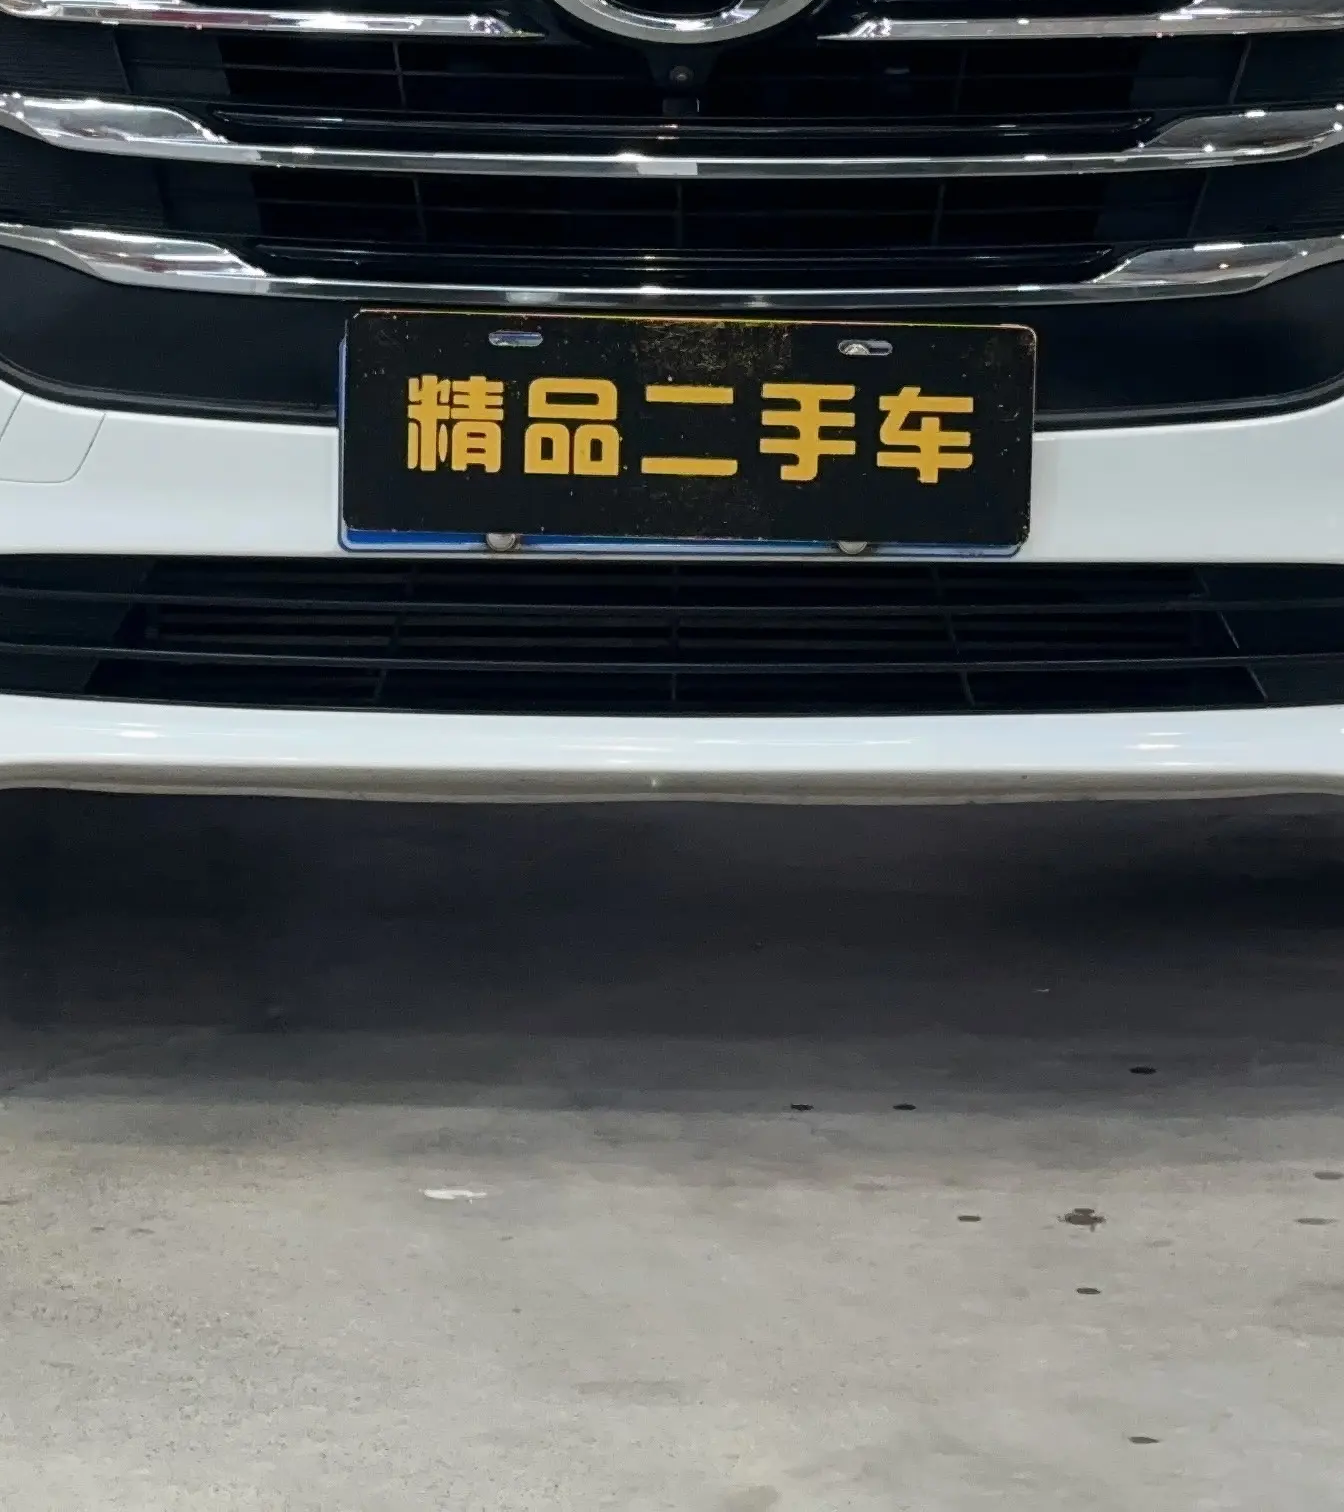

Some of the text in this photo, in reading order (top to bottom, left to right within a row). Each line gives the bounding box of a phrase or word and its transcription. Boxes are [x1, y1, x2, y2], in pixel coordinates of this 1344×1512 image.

[406, 373, 974, 484] 精品二手车
